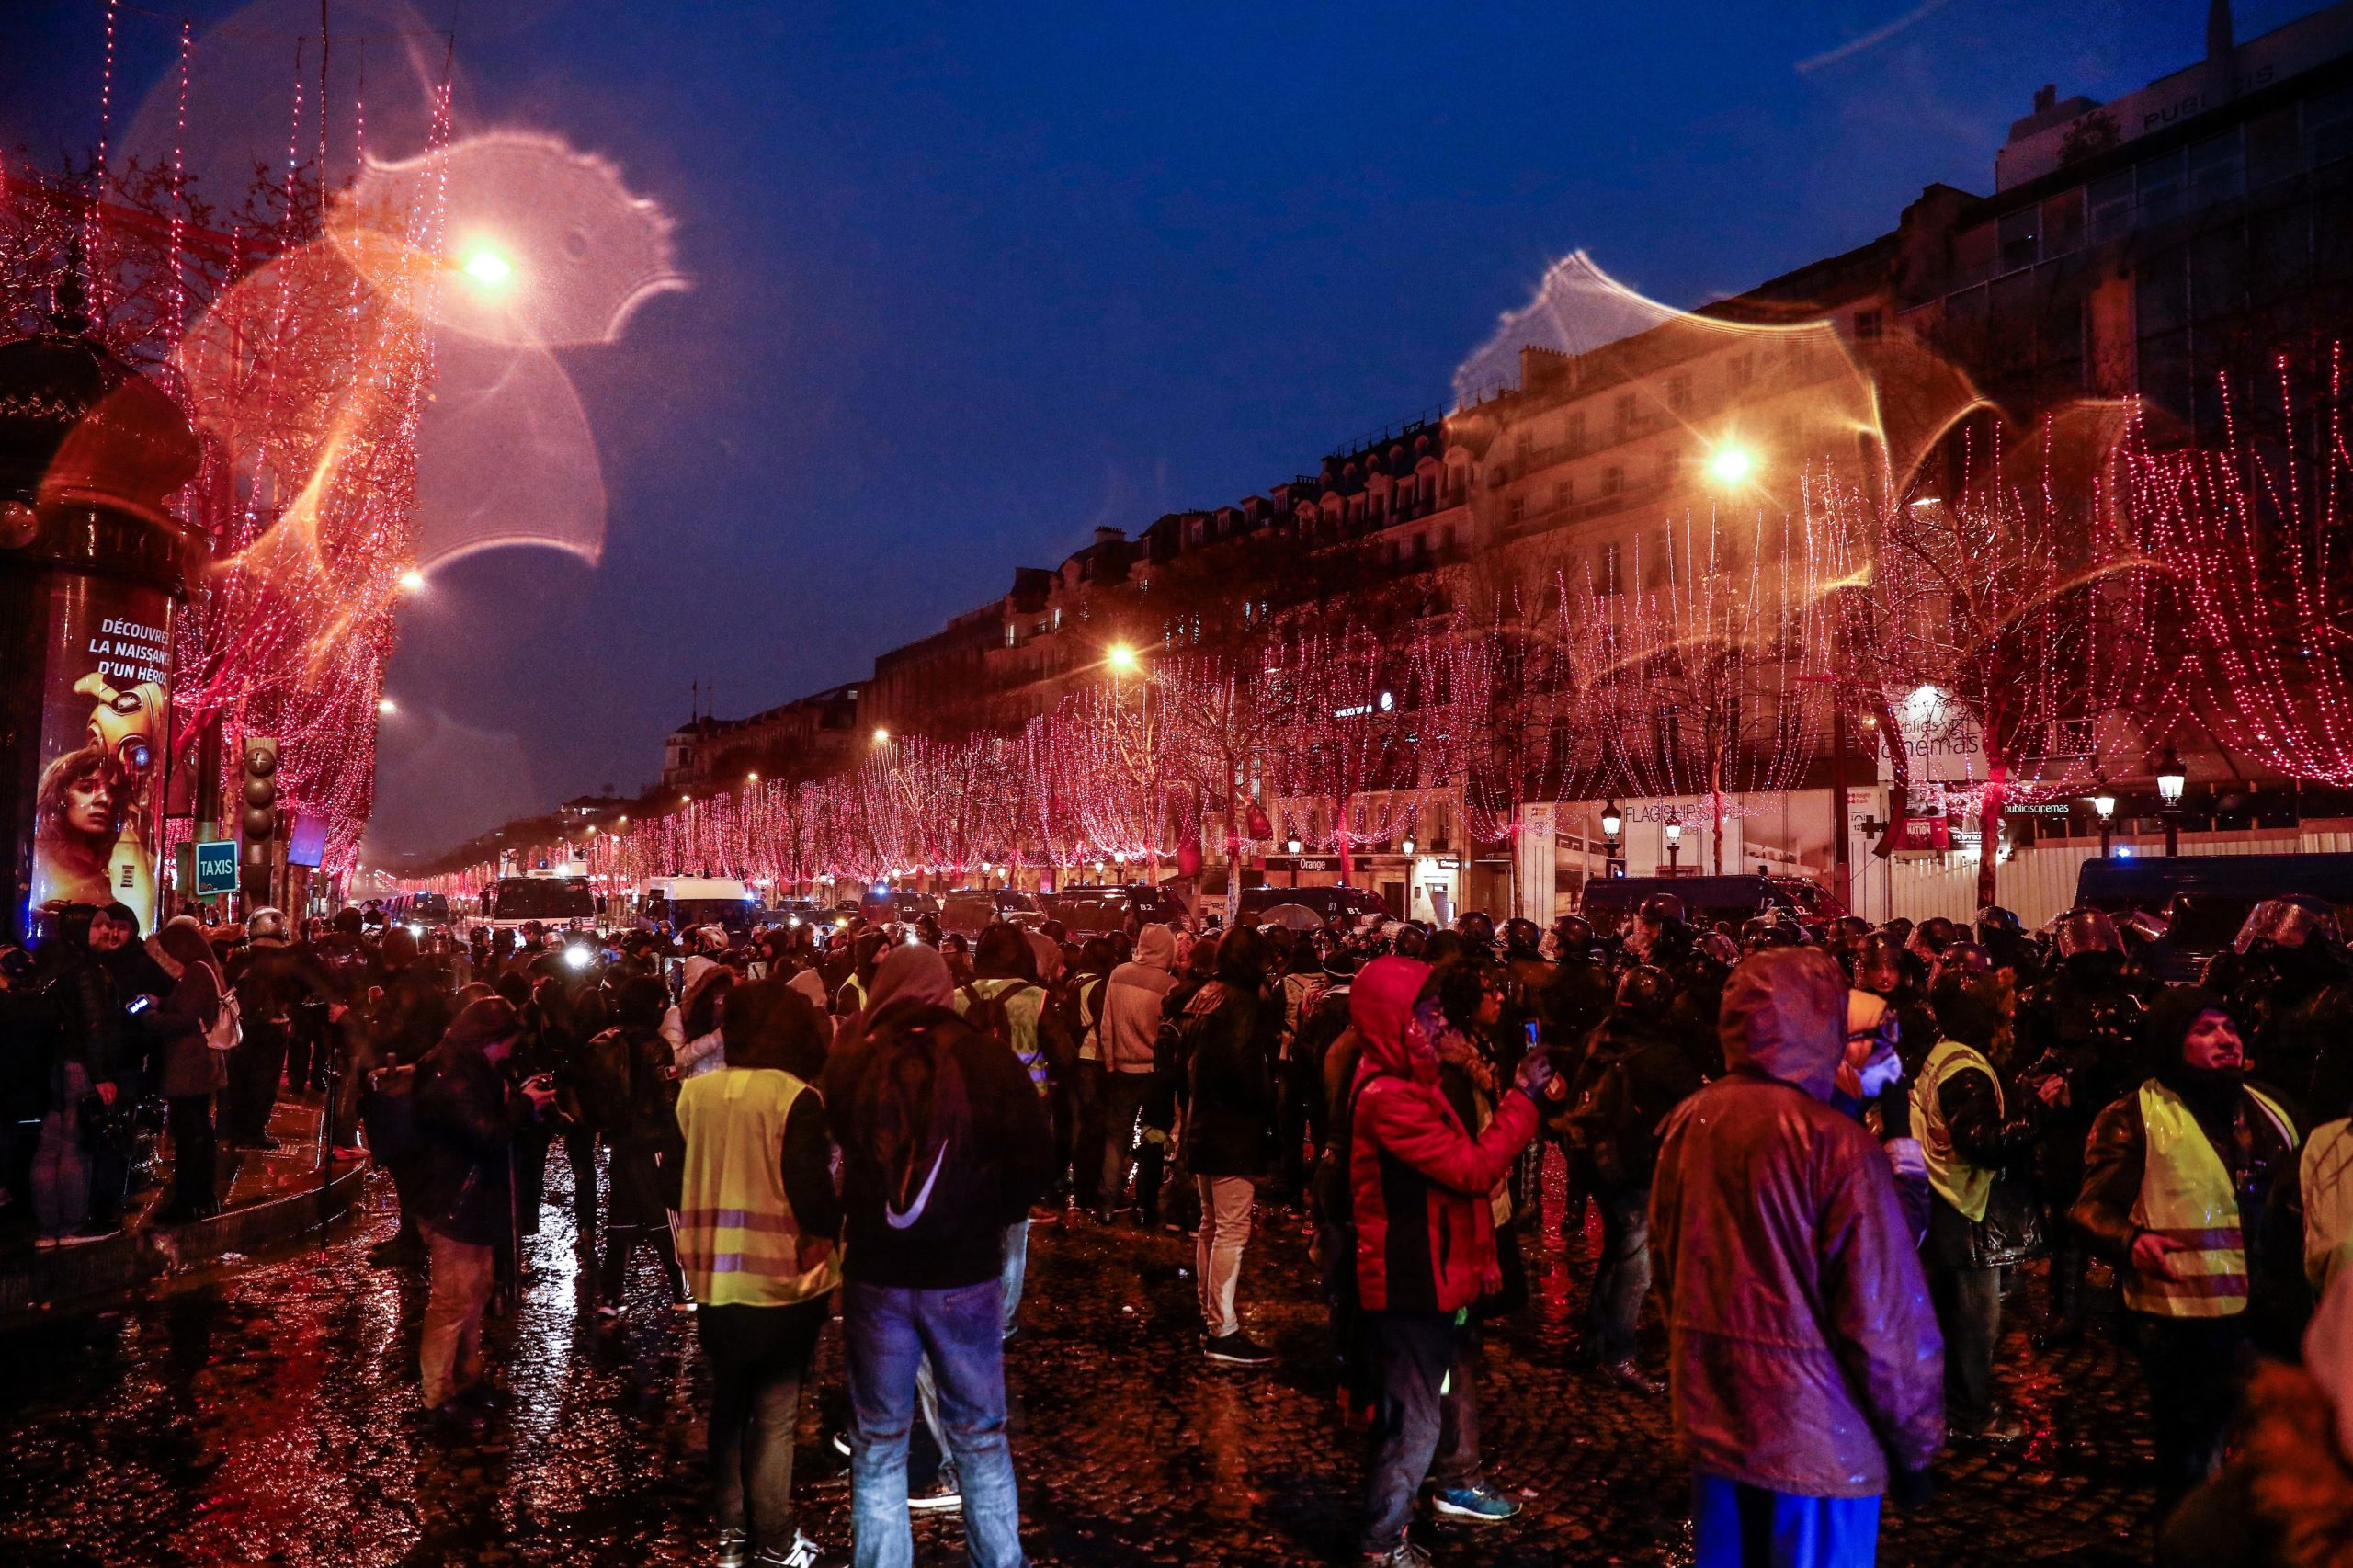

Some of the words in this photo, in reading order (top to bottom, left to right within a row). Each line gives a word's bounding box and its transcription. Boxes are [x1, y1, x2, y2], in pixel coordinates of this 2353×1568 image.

[101, 617, 169, 645] DÉCOUVREZ
[89, 638, 110, 653] LA
[98, 660, 135, 679] D'UN
[1881, 733, 1979, 759] cnémas
[200, 859, 233, 876] TAXIS
[1300, 854, 1326, 871] Orange
